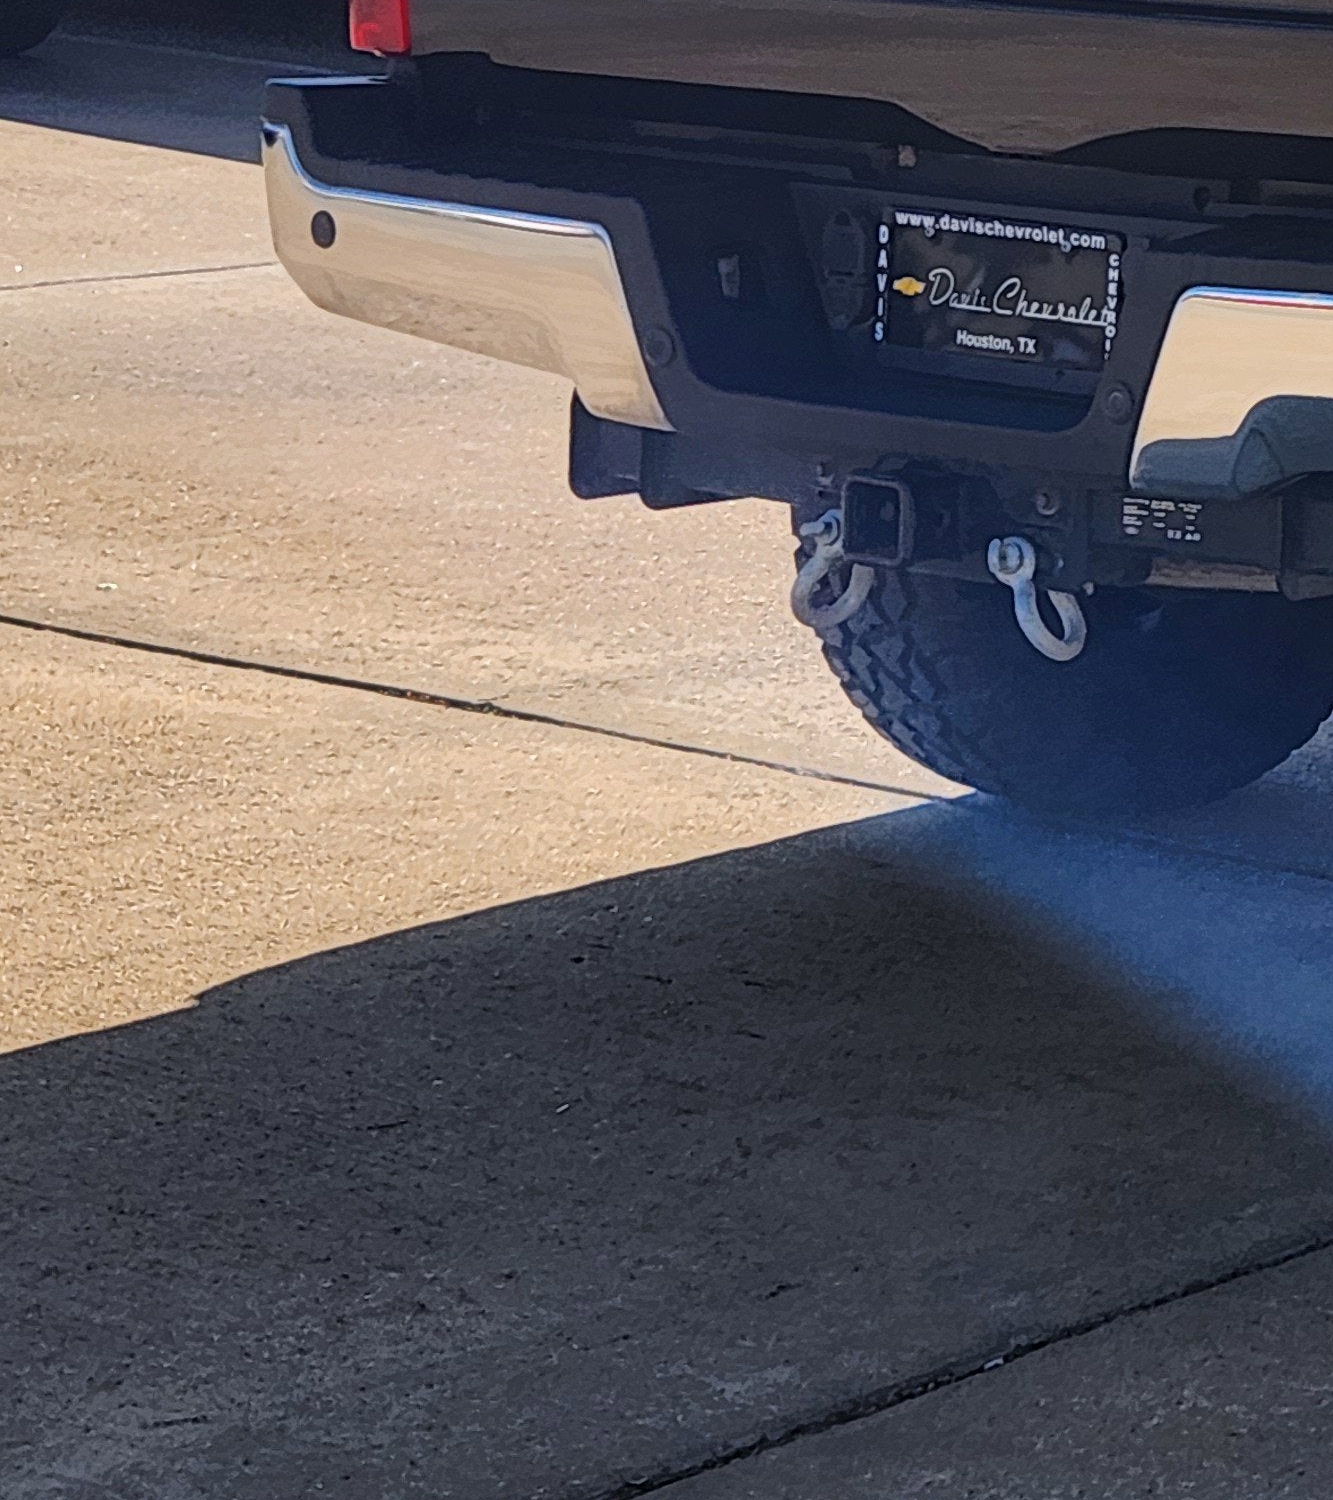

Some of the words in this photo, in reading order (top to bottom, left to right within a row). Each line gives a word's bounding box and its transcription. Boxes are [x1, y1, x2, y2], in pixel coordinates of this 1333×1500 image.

[895, 210, 1106, 250] www.davischevrolet.com
[874, 223, 890, 342] DAVIS
[928, 267, 993, 313] Davis
[956, 329, 1015, 354] Houston,
[1017, 336, 1037, 354] TX
